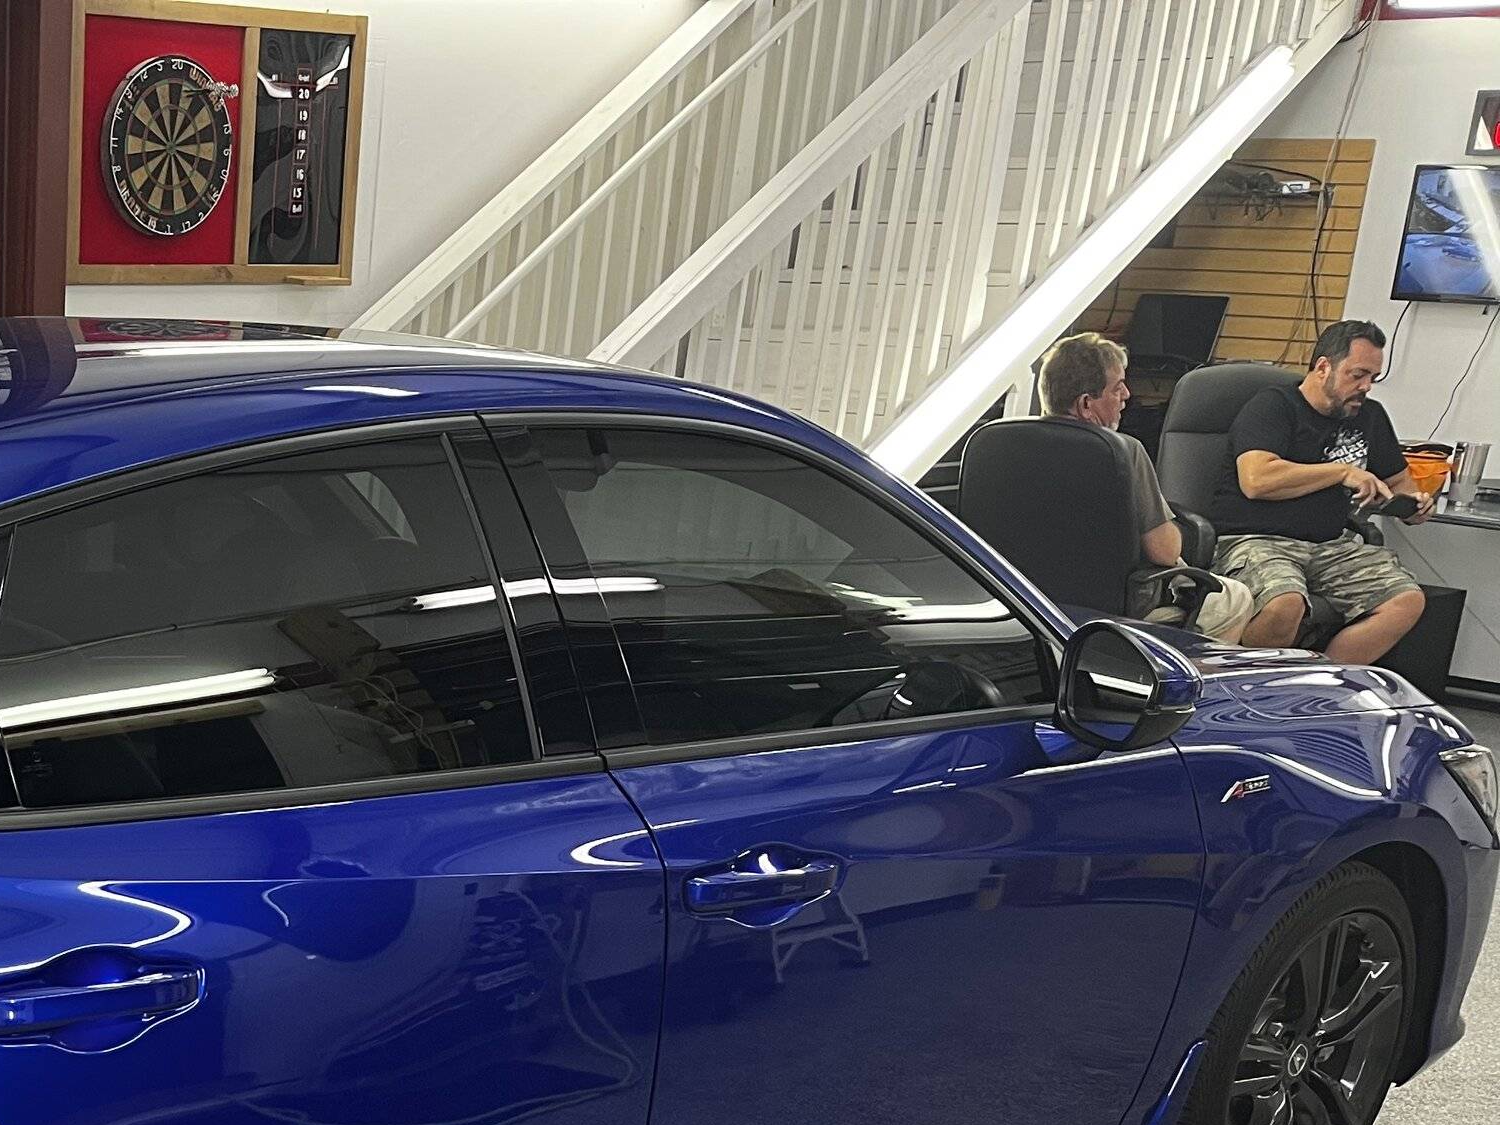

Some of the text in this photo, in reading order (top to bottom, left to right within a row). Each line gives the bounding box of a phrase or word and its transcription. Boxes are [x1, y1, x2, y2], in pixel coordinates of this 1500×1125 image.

[171, 60, 184, 70] 20
[298, 88, 310, 99] 20
[299, 110, 308, 121] 19
[296, 149, 306, 160] 17
[296, 168, 304, 180] 16
[292, 187, 302, 198] 15
